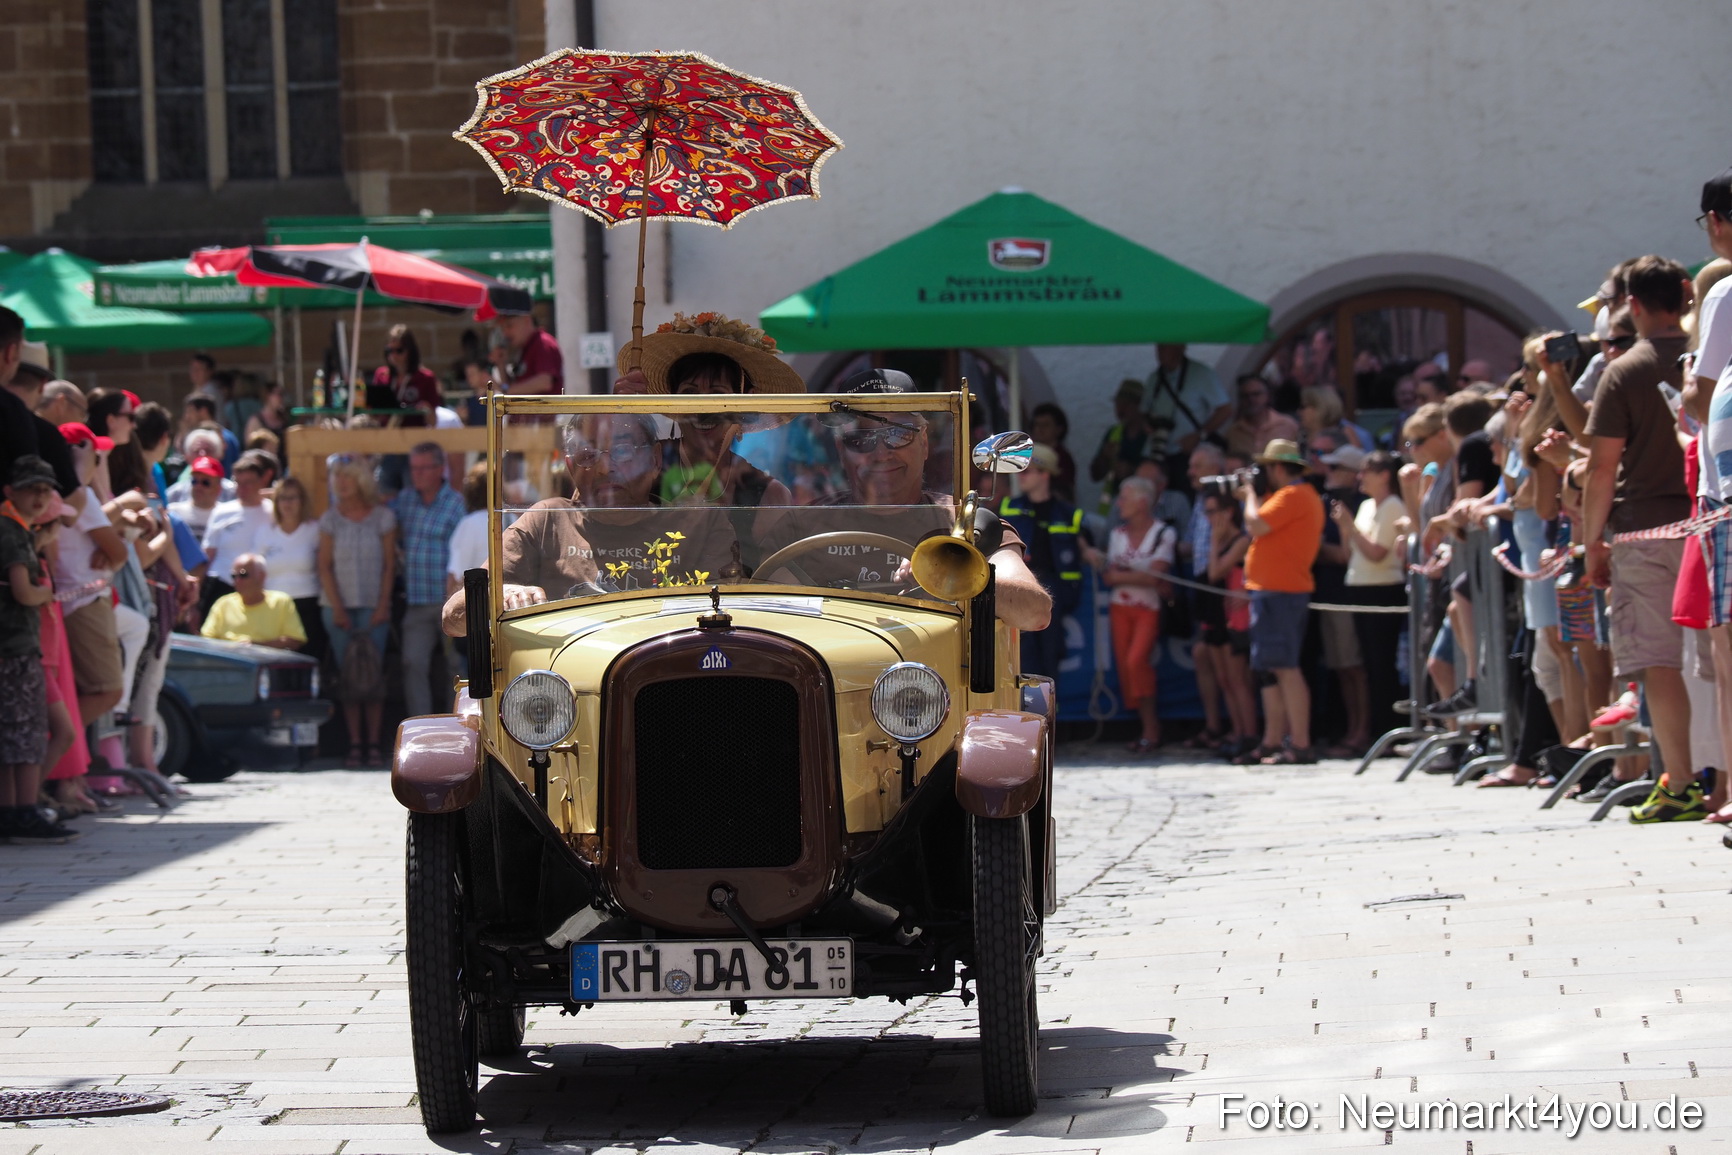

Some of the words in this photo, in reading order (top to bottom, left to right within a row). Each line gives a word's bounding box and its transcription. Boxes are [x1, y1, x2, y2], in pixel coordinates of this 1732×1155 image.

[702, 651, 727, 669] DIXI
[828, 947, 846, 960] 05
[582, 978, 591, 990] D
[602, 949, 660, 993] RH
[693, 948, 750, 991] DA
[765, 947, 819, 990] 81
[829, 976, 846, 990] 10
